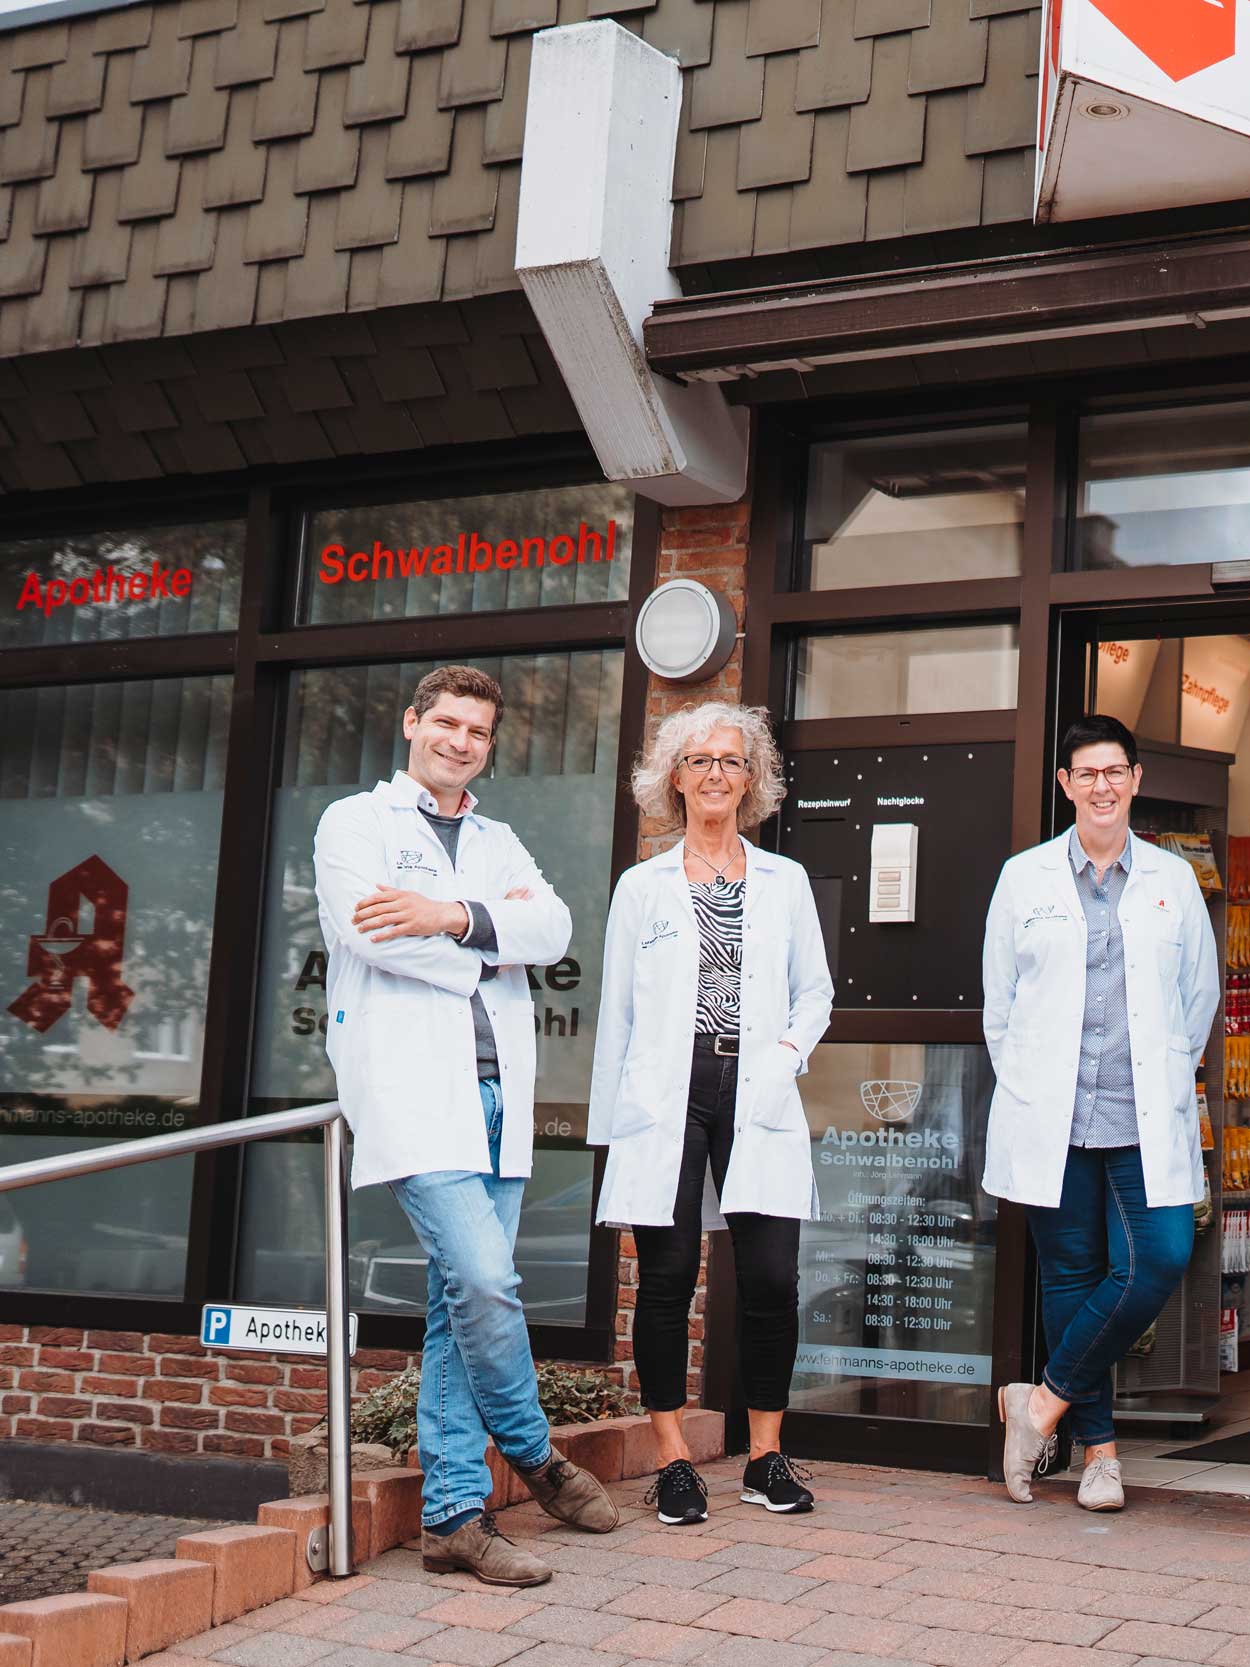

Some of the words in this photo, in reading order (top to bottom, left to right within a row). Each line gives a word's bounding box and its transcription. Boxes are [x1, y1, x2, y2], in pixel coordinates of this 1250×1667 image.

[16, 561, 193, 617] Apotheke
[318, 520, 617, 584] Schwalbenohl
[798, 798, 851, 809] Rezepteinwurf
[877, 796, 924, 807] Nachtglocke
[821, 1126, 960, 1150] Apotheke
[820, 1151, 958, 1169] Schwalbenohl
[847, 1190, 925, 1208] Öffnungszeiten:
[870, 1212, 897, 1225] 08:30
[908, 1214, 935, 1227] 12:30
[937, 1215, 956, 1227] Uhr
[869, 1233, 896, 1245] 14:30
[907, 1234, 934, 1247] 18:00
[937, 1235, 955, 1248] Uhr
[868, 1253, 895, 1266] 08:30
[906, 1255, 933, 1268] 12:30
[936, 1255, 953, 1268] Uhr
[867, 1273, 894, 1286] 08:30
[905, 1276, 933, 1288] 12:30
[935, 1276, 953, 1289] Uhr
[867, 1294, 893, 1306] 14:30
[905, 1296, 932, 1309] 18:00
[935, 1297, 952, 1310] Uhr
[209, 1311, 228, 1340] P
[245, 1316, 345, 1344] Apothek
[813, 1311, 831, 1323] Sa.:
[865, 1314, 893, 1327] 08:30
[904, 1317, 931, 1329] 12:30
[934, 1318, 952, 1331] Uhr
[795, 1352, 975, 1375] ww.lehmanns-apotheke.de
